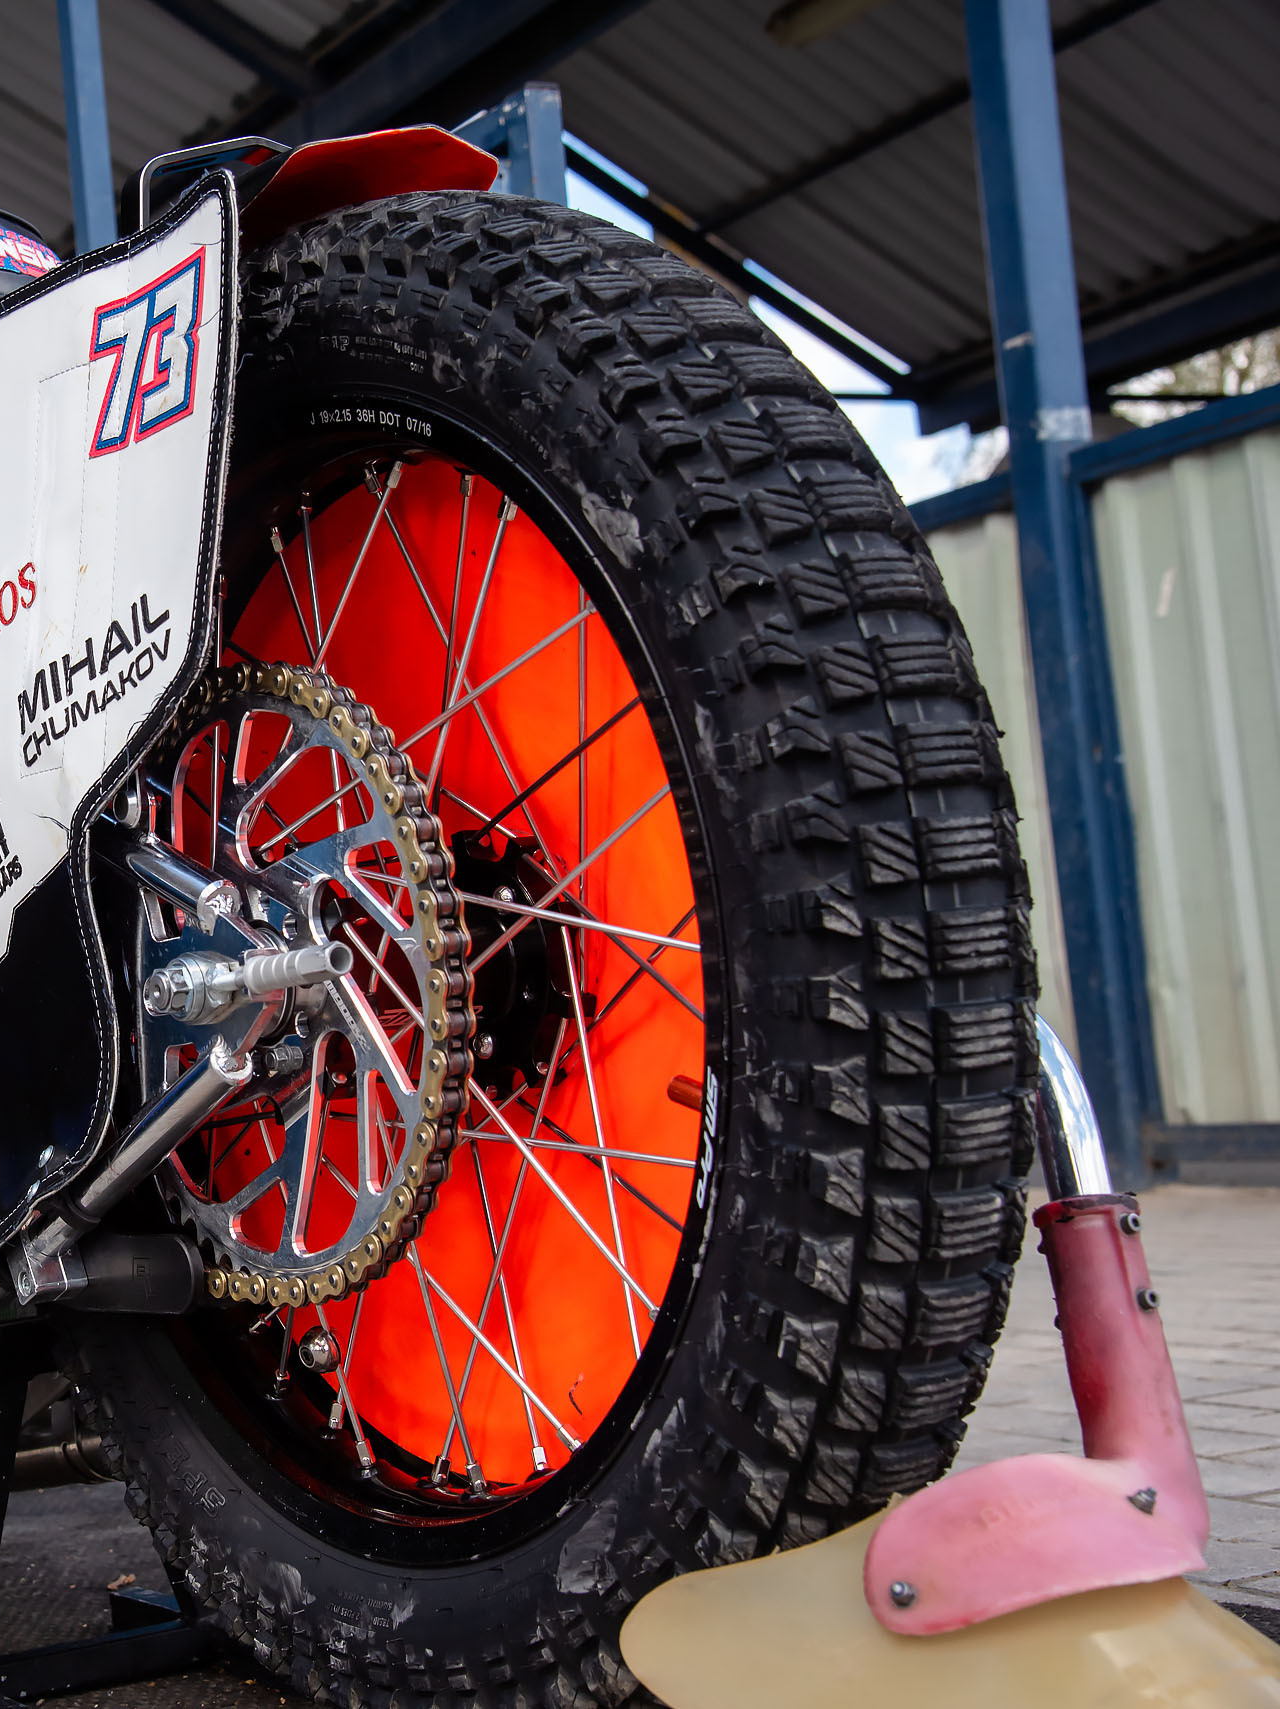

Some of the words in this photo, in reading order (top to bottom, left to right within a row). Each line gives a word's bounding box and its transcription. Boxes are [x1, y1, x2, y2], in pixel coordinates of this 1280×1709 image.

[89, 247, 206, 458] 73
[319, 408, 353, 425] 19x2.15
[356, 408, 376, 423] 36H
[379, 410, 401, 428] DOT
[406, 417, 432, 437] 07/16
[17, 593, 170, 735] MIHAIL
[21, 627, 173, 768] CHUMAKOV
